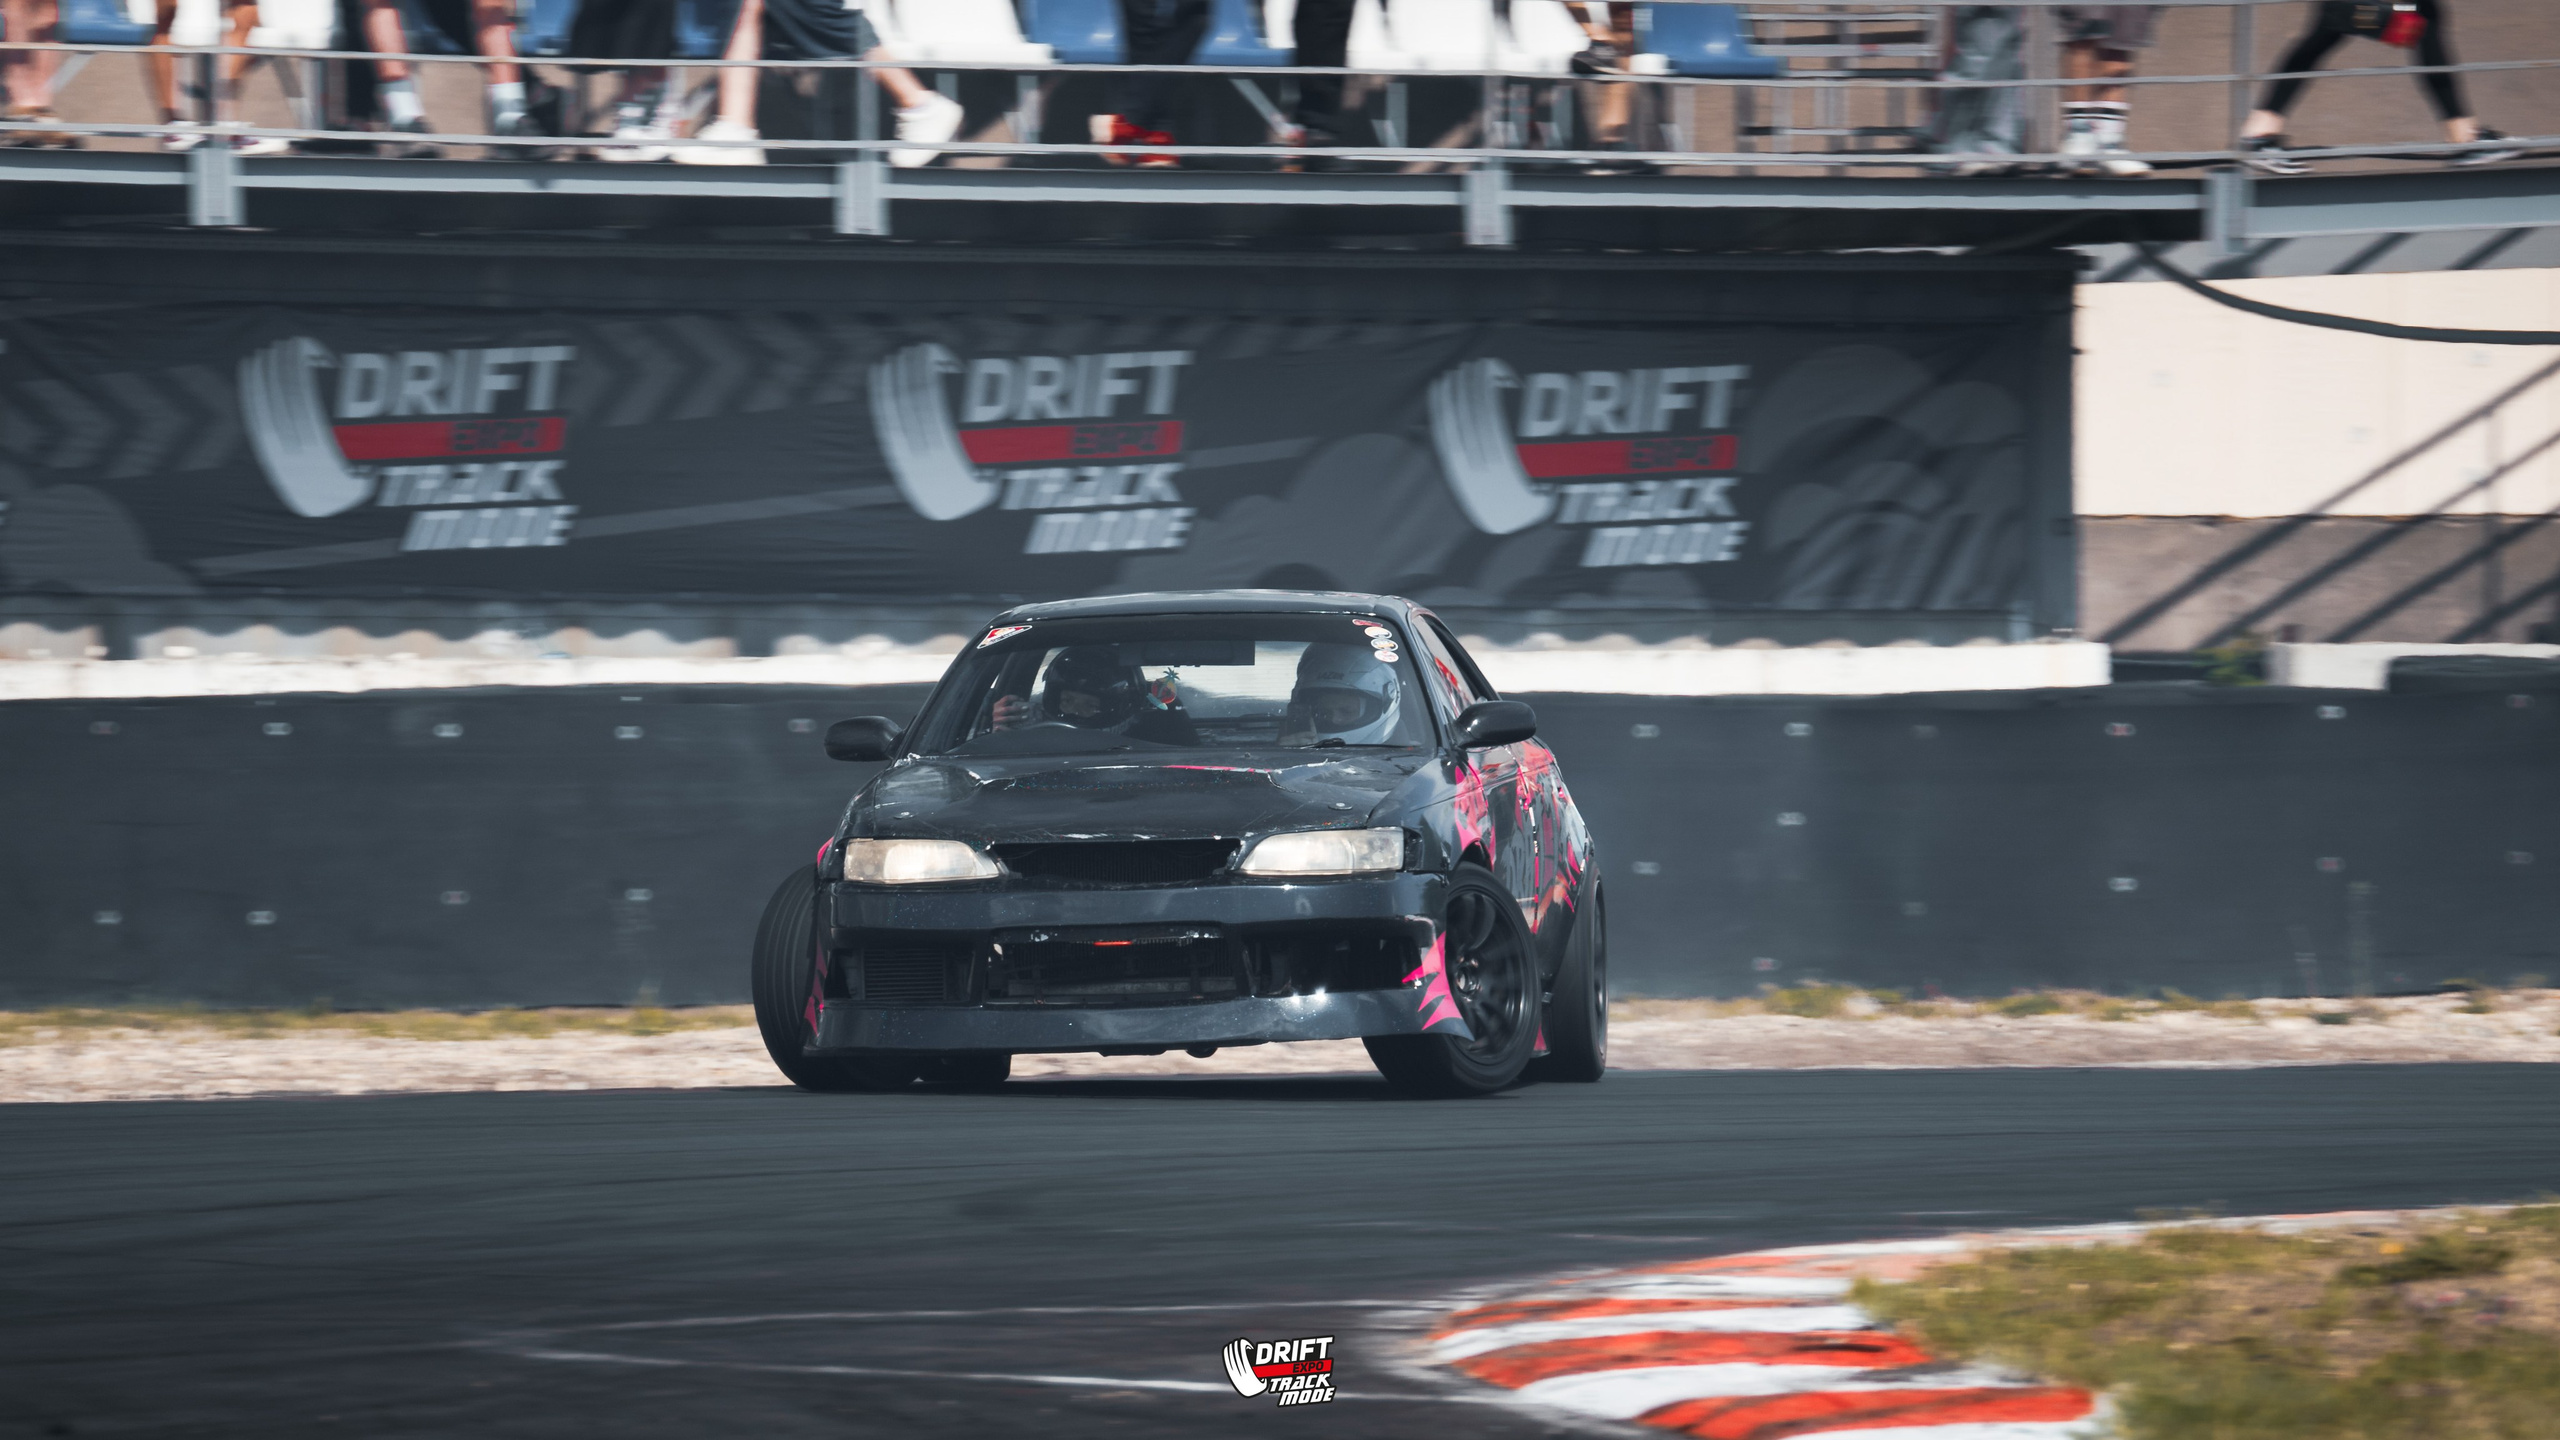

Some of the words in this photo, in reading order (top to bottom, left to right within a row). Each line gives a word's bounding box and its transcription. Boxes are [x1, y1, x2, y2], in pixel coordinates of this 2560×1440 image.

[333, 346, 577, 418] DRIFT
[961, 350, 1197, 423] DRIFT
[1517, 364, 1753, 437] DRIFT
